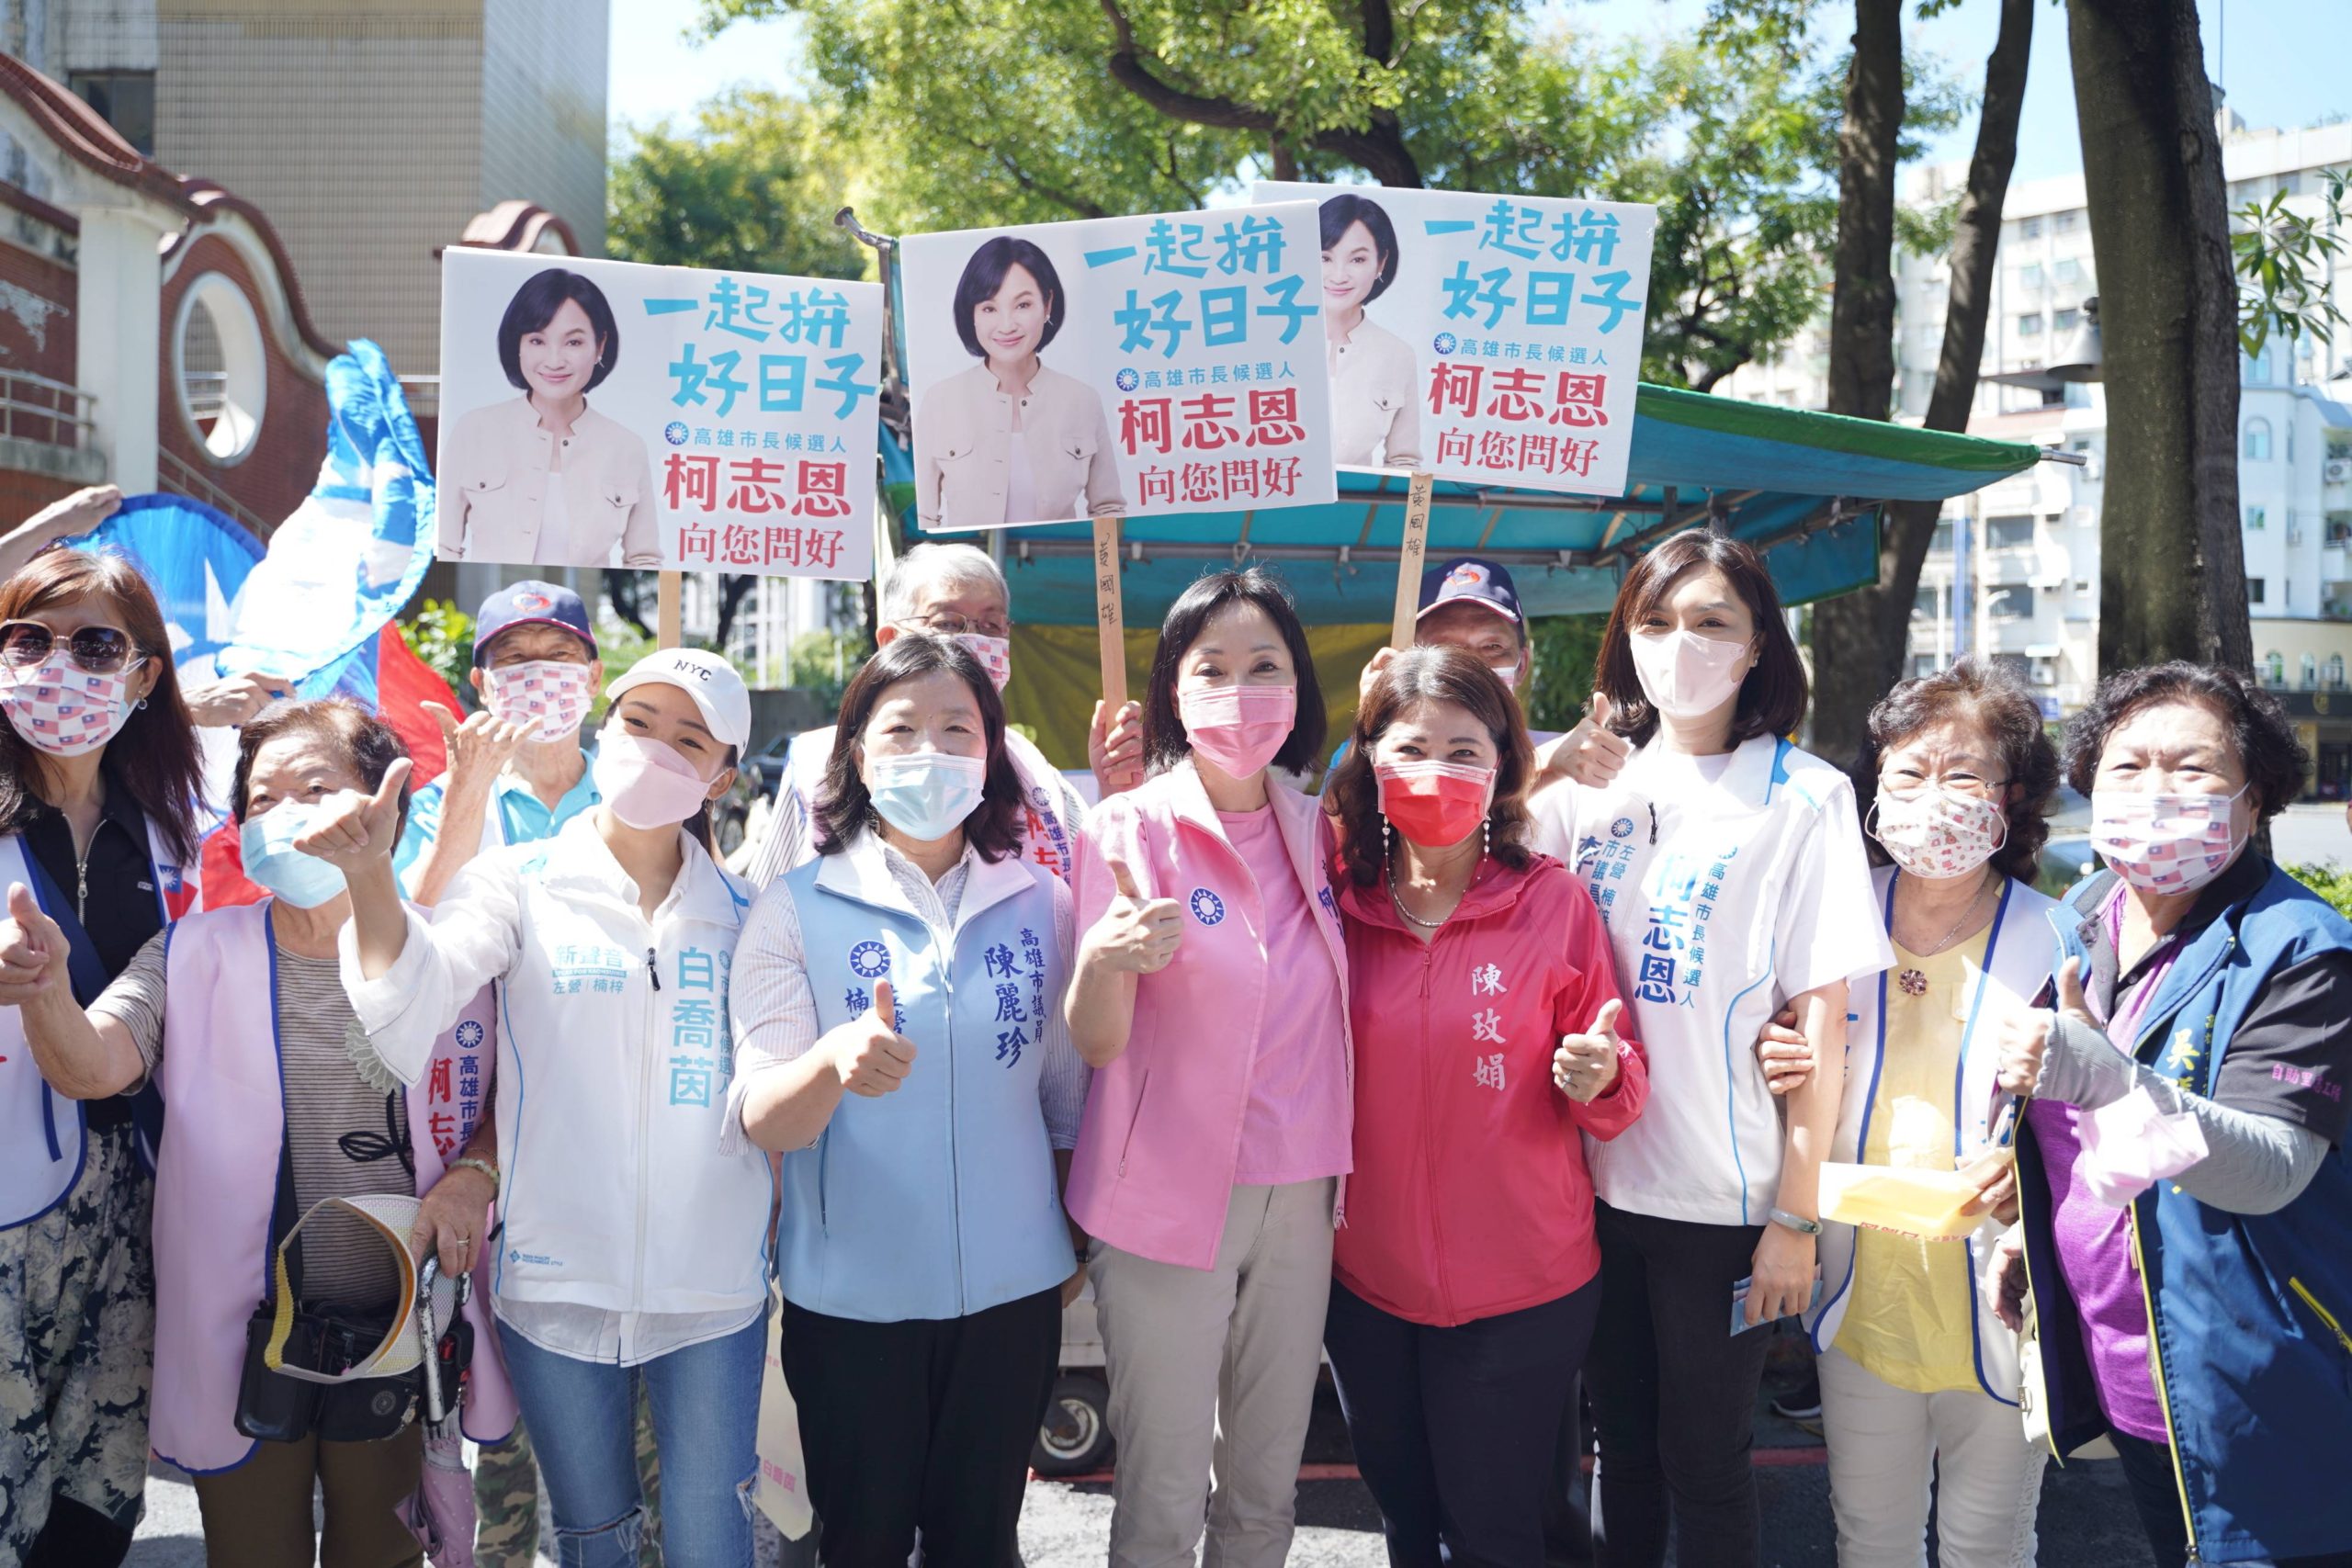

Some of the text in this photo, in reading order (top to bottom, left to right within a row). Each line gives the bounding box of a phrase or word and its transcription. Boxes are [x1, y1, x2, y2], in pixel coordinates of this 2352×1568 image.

[1114, 274, 1319, 359] 好日子
[1442, 260, 1642, 334] 好日子
[669, 343, 876, 421] 好日子
[1144, 361, 1295, 389] 高雄市長候選人
[1460, 337, 1609, 367] 高雄市長候選人
[1118, 388, 1306, 456] 柯志恩
[1427, 362, 1610, 428] 柯志恩
[694, 427, 847, 454] 高雄市長候選人
[1436, 427, 1600, 478] 向您問好
[663, 453, 853, 518] 柯志恩
[1138, 457, 1303, 506] 向您問好
[679, 522, 845, 569] 向您問好
[673, 659, 712, 682] NYC
[1679, 862, 1728, 1009] 高雄市長候選人
[983, 942, 1030, 1070] 陳麗珍
[1020, 928, 1047, 1044] 高雄市議員
[669, 946, 716, 1108] 白喬茵
[1471, 963, 1508, 1091] 陳玫娟
[459, 1055, 480, 1156] 高雄市長
